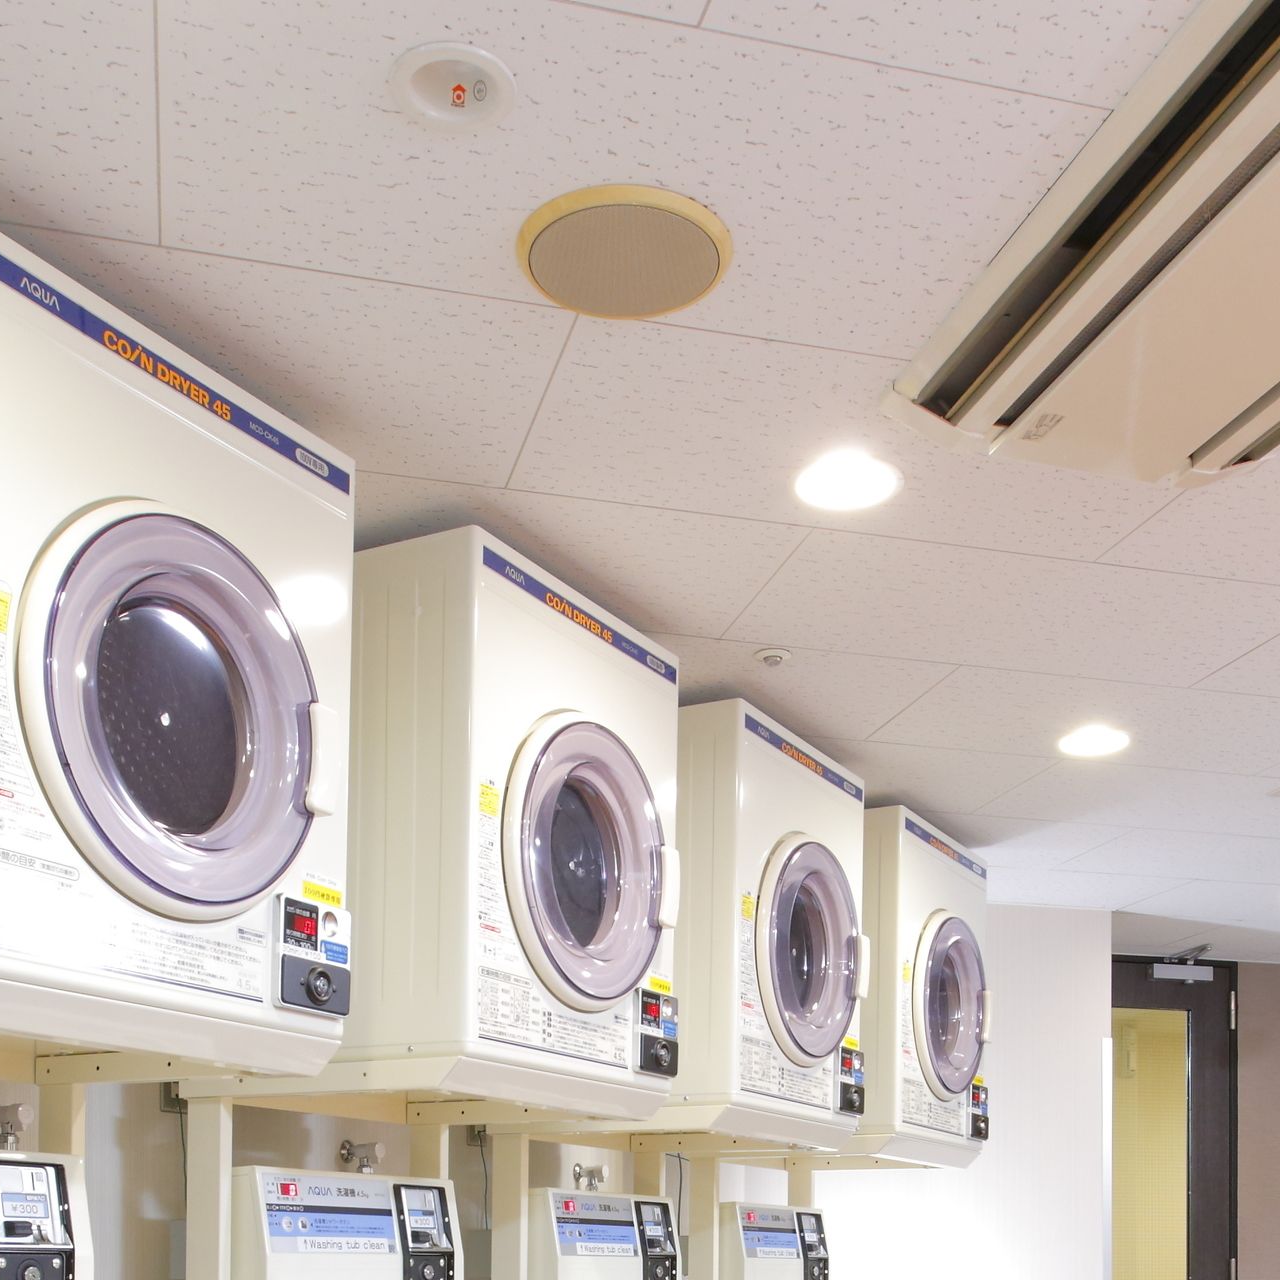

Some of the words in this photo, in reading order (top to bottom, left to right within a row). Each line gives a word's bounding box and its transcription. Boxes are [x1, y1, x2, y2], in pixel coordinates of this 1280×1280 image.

[20, 276, 60, 311] AQUA
[156, 363, 210, 409] DRYER
[213, 399, 231, 421] 45
[573, 609, 601, 637] DRYER
[307, 1186, 333, 1197] AQUA
[12, 1203, 38, 1215] ¥300
[310, 1239, 343, 1250] Washing
[346, 1239, 360, 1249] tub
[364, 1240, 385, 1250] clean
